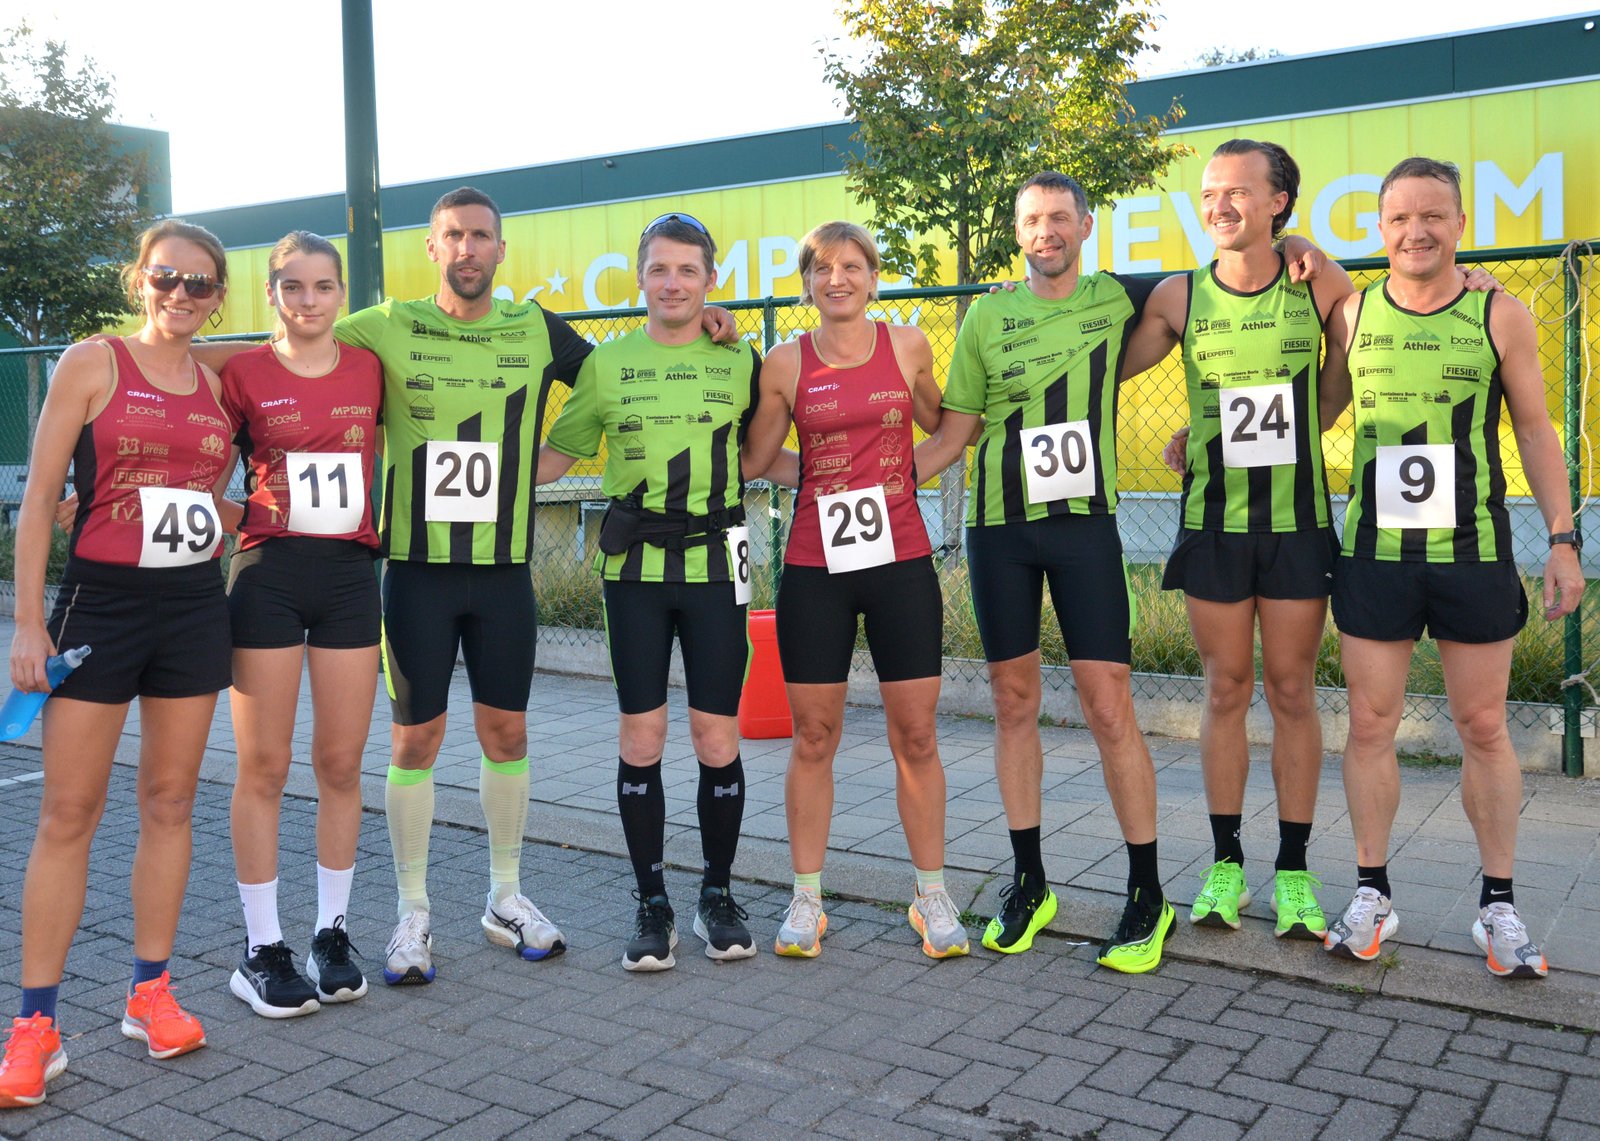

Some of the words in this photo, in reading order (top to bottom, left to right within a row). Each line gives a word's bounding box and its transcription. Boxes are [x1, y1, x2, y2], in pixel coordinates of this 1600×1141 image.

[1082, 318, 1109, 330] FIESIEK
[1240, 320, 1276, 332] Athlex
[458, 334, 492, 344] Athlex
[1284, 340, 1311, 349] FIESIEK
[1403, 341, 1440, 351] Athlex
[422, 354, 451, 363] EXPERTS
[1206, 349, 1234, 358] EXPERTS
[500, 356, 527, 364] FIESIEK
[665, 372, 698, 381] Athlex
[1366, 367, 1393, 375] EXPERTS
[1446, 366, 1479, 377] FIESIEK
[808, 384, 833, 394] CRAFT
[127, 390, 157, 402] CRAFT
[706, 391, 731, 401] FIESIEK
[261, 398, 289, 408] CRAFT
[1229, 393, 1290, 443] 24
[143, 446, 169, 457] press
[1031, 429, 1087, 478] 30
[815, 457, 848, 470] FIESIEK
[879, 456, 904, 468] MKH
[118, 471, 165, 485] FIESIEK
[434, 451, 492, 498] 20
[1399, 455, 1436, 504] 9
[298, 463, 348, 509] 11
[152, 502, 216, 554] 49
[827, 496, 883, 548] 29
[737, 539, 749, 584] 8
